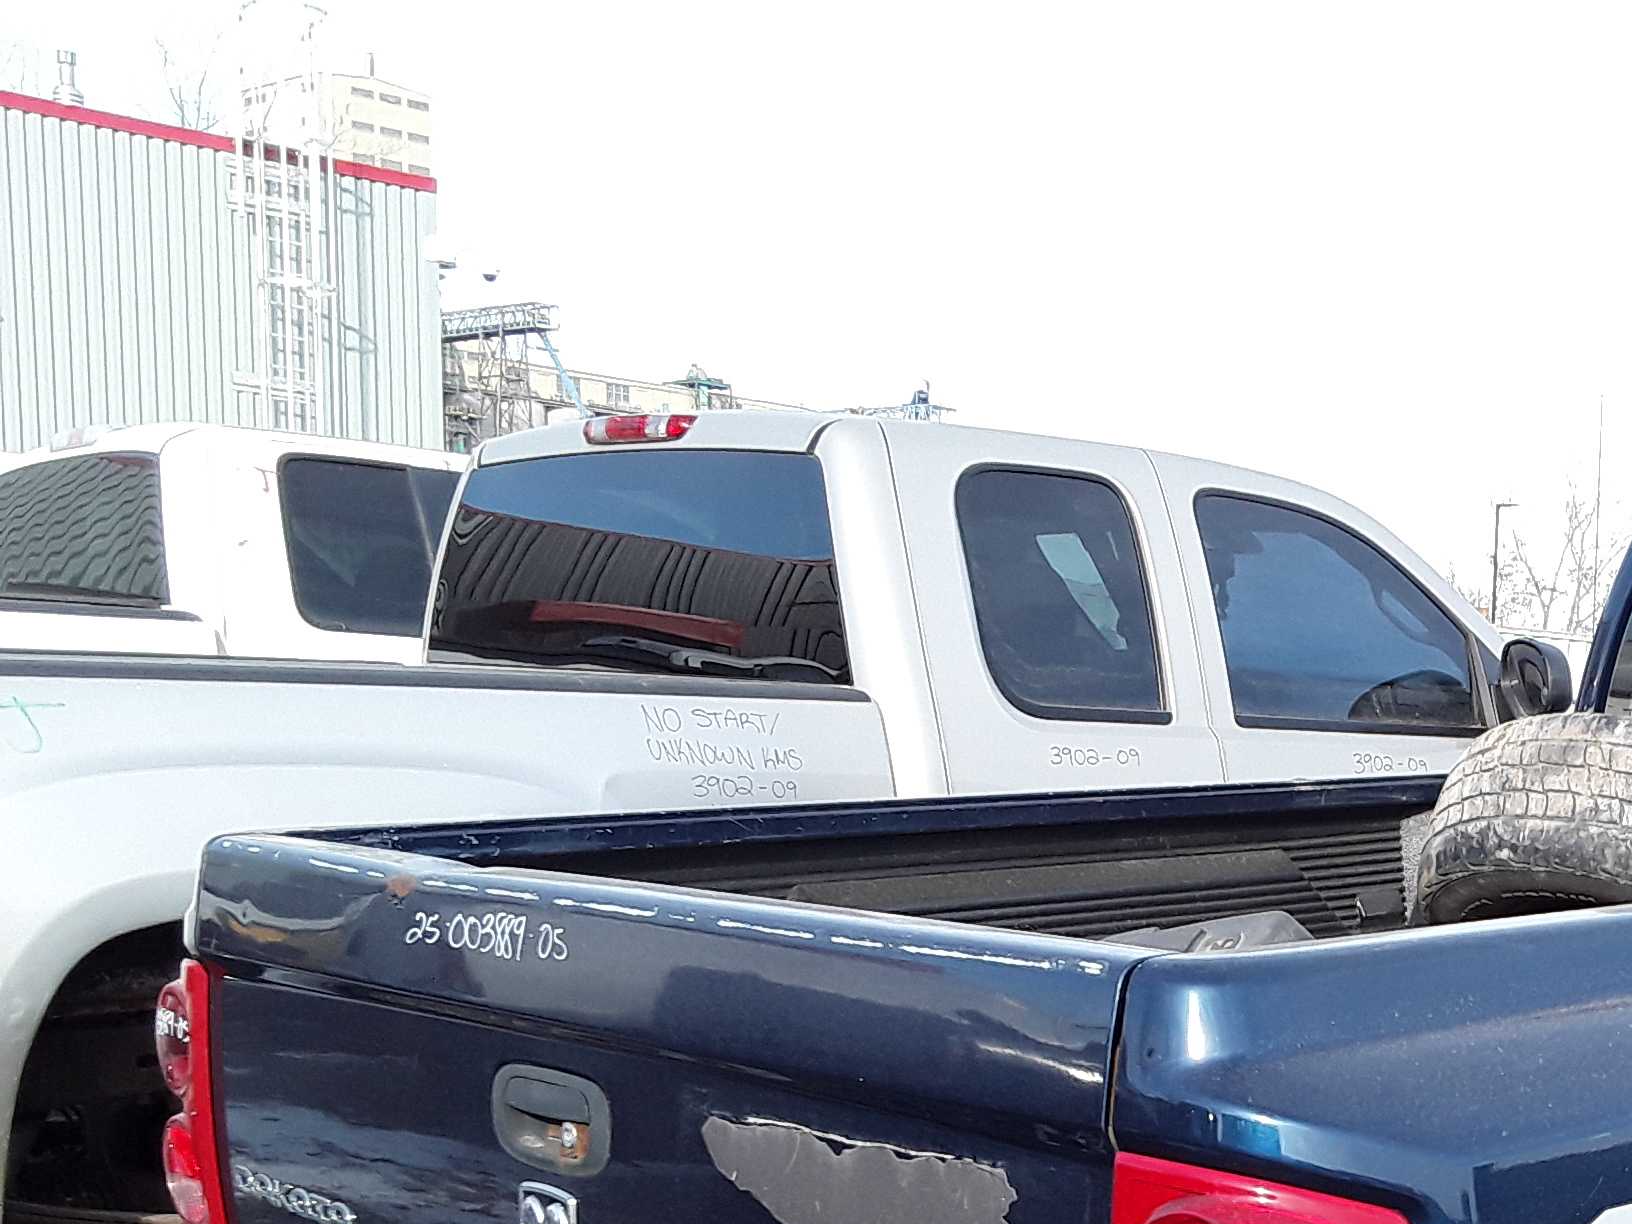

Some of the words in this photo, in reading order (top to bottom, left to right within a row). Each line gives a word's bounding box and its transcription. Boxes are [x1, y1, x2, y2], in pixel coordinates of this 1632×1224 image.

[641, 704, 682, 733] NO
[646, 737, 755, 770] UNKNOWN
[1049, 745, 1141, 767] 3902-09
[691, 774, 797, 800] 3902-09
